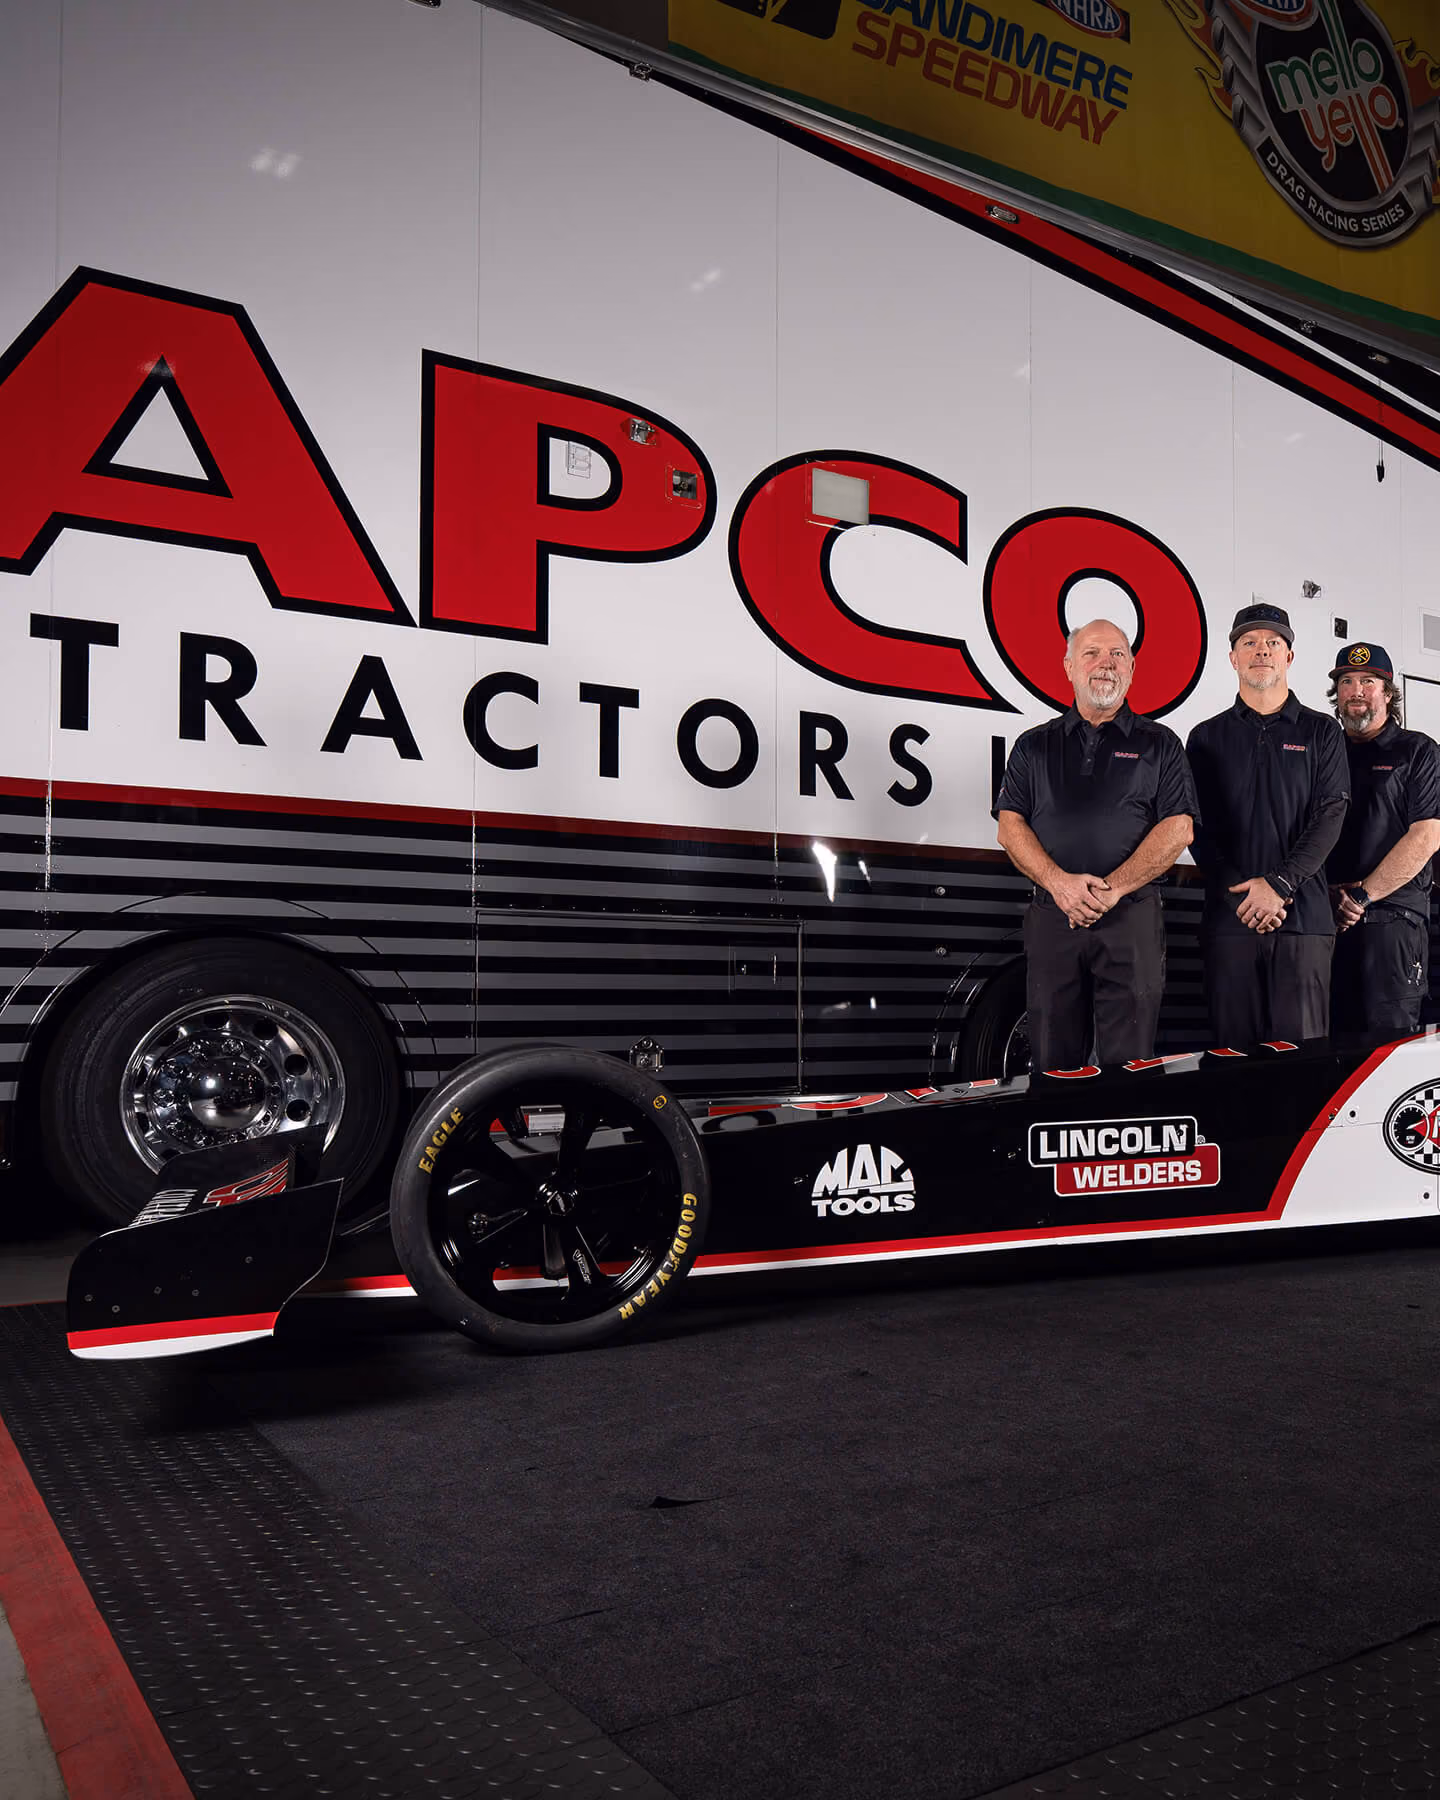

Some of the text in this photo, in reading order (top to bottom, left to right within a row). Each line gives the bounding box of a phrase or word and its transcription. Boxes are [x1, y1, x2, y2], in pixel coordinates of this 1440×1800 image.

[851, 11, 1119, 145] SPEEDWAY
[857, 0, 1133, 110] ANDIMERE
[1264, 30, 1384, 112] mello
[1301, 84, 1400, 190] yello
[1265, 151, 1405, 233] DRAG RACING SERIES
[30, 613, 933, 807] TRACTORS
[418, 1106, 465, 1175] EAGLE
[811, 1143, 915, 1197] MAC
[1040, 1124, 1188, 1159] LINCOLN
[1073, 1160, 1202, 1189] WELDERS
[812, 1193, 915, 1217] TOOLS
